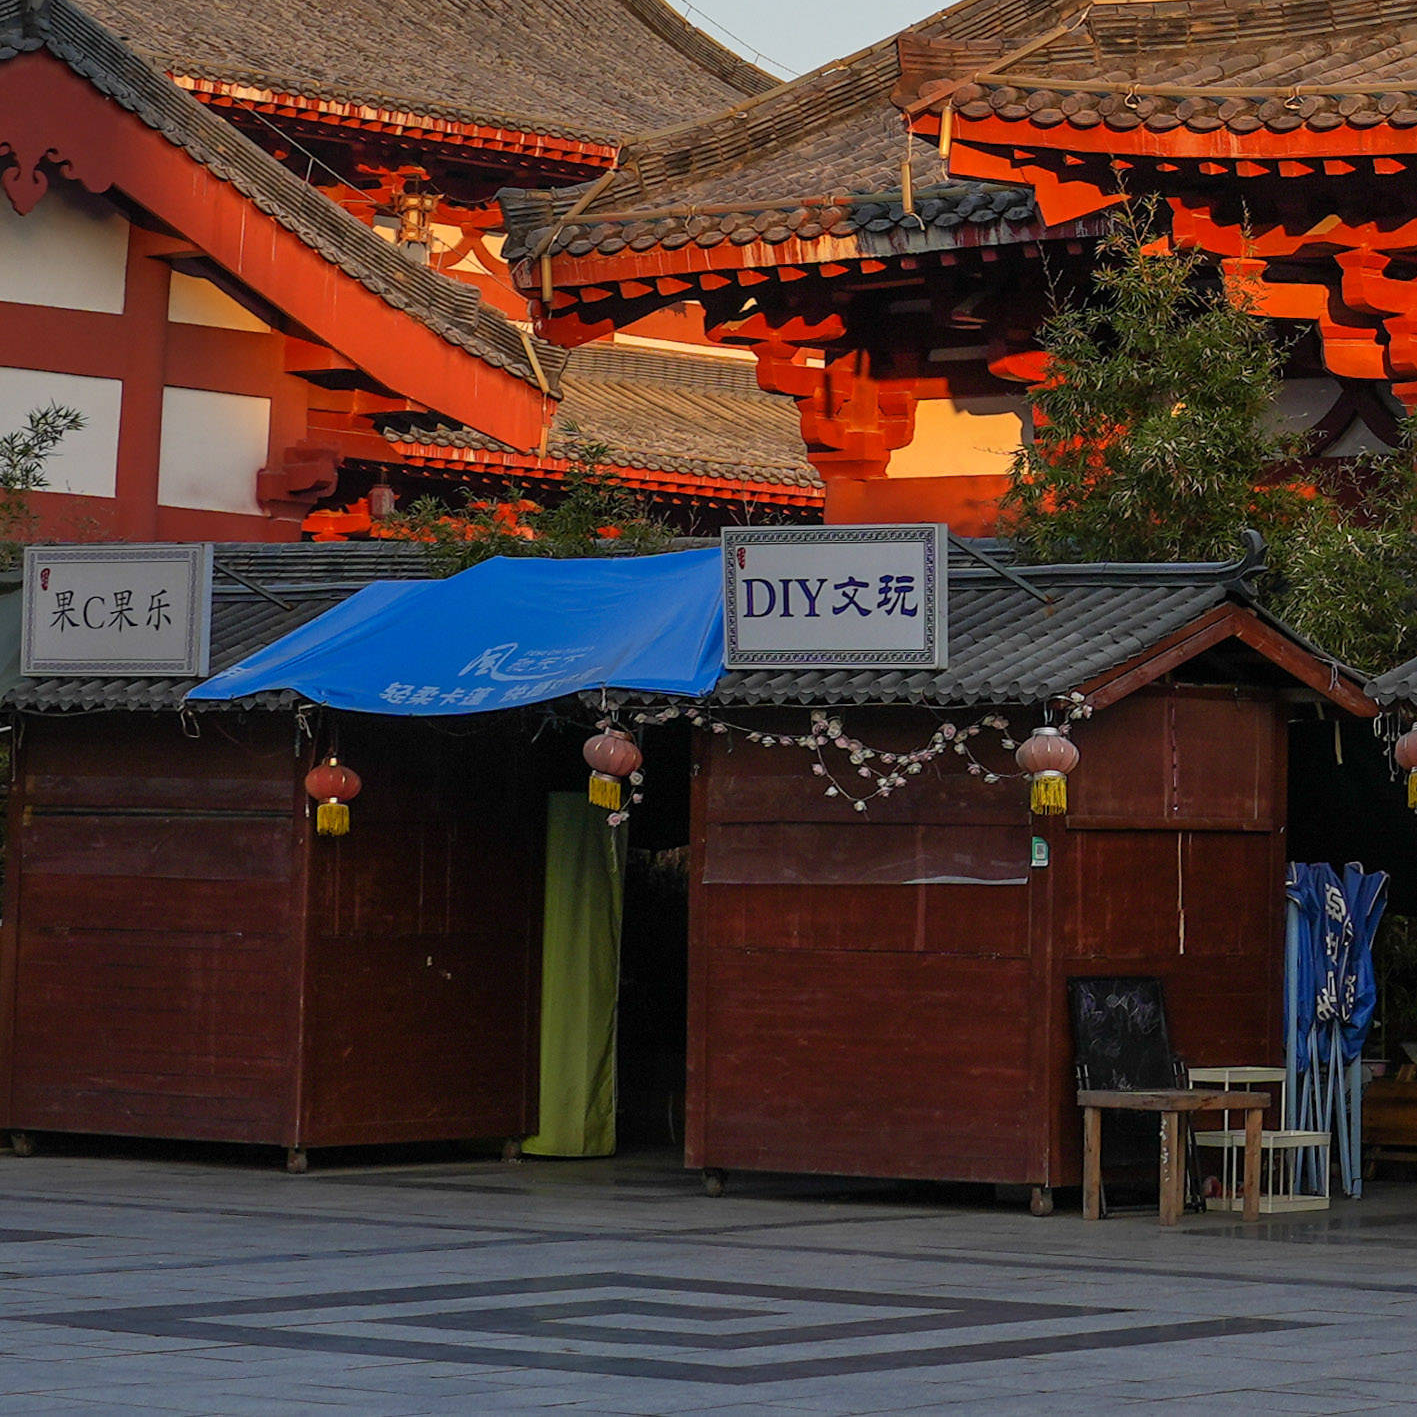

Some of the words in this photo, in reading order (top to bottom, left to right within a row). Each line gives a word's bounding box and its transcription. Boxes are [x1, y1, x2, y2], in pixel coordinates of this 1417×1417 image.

[50, 589, 172, 633] 果C果乐
[741, 574, 919, 618] DIY文玩
